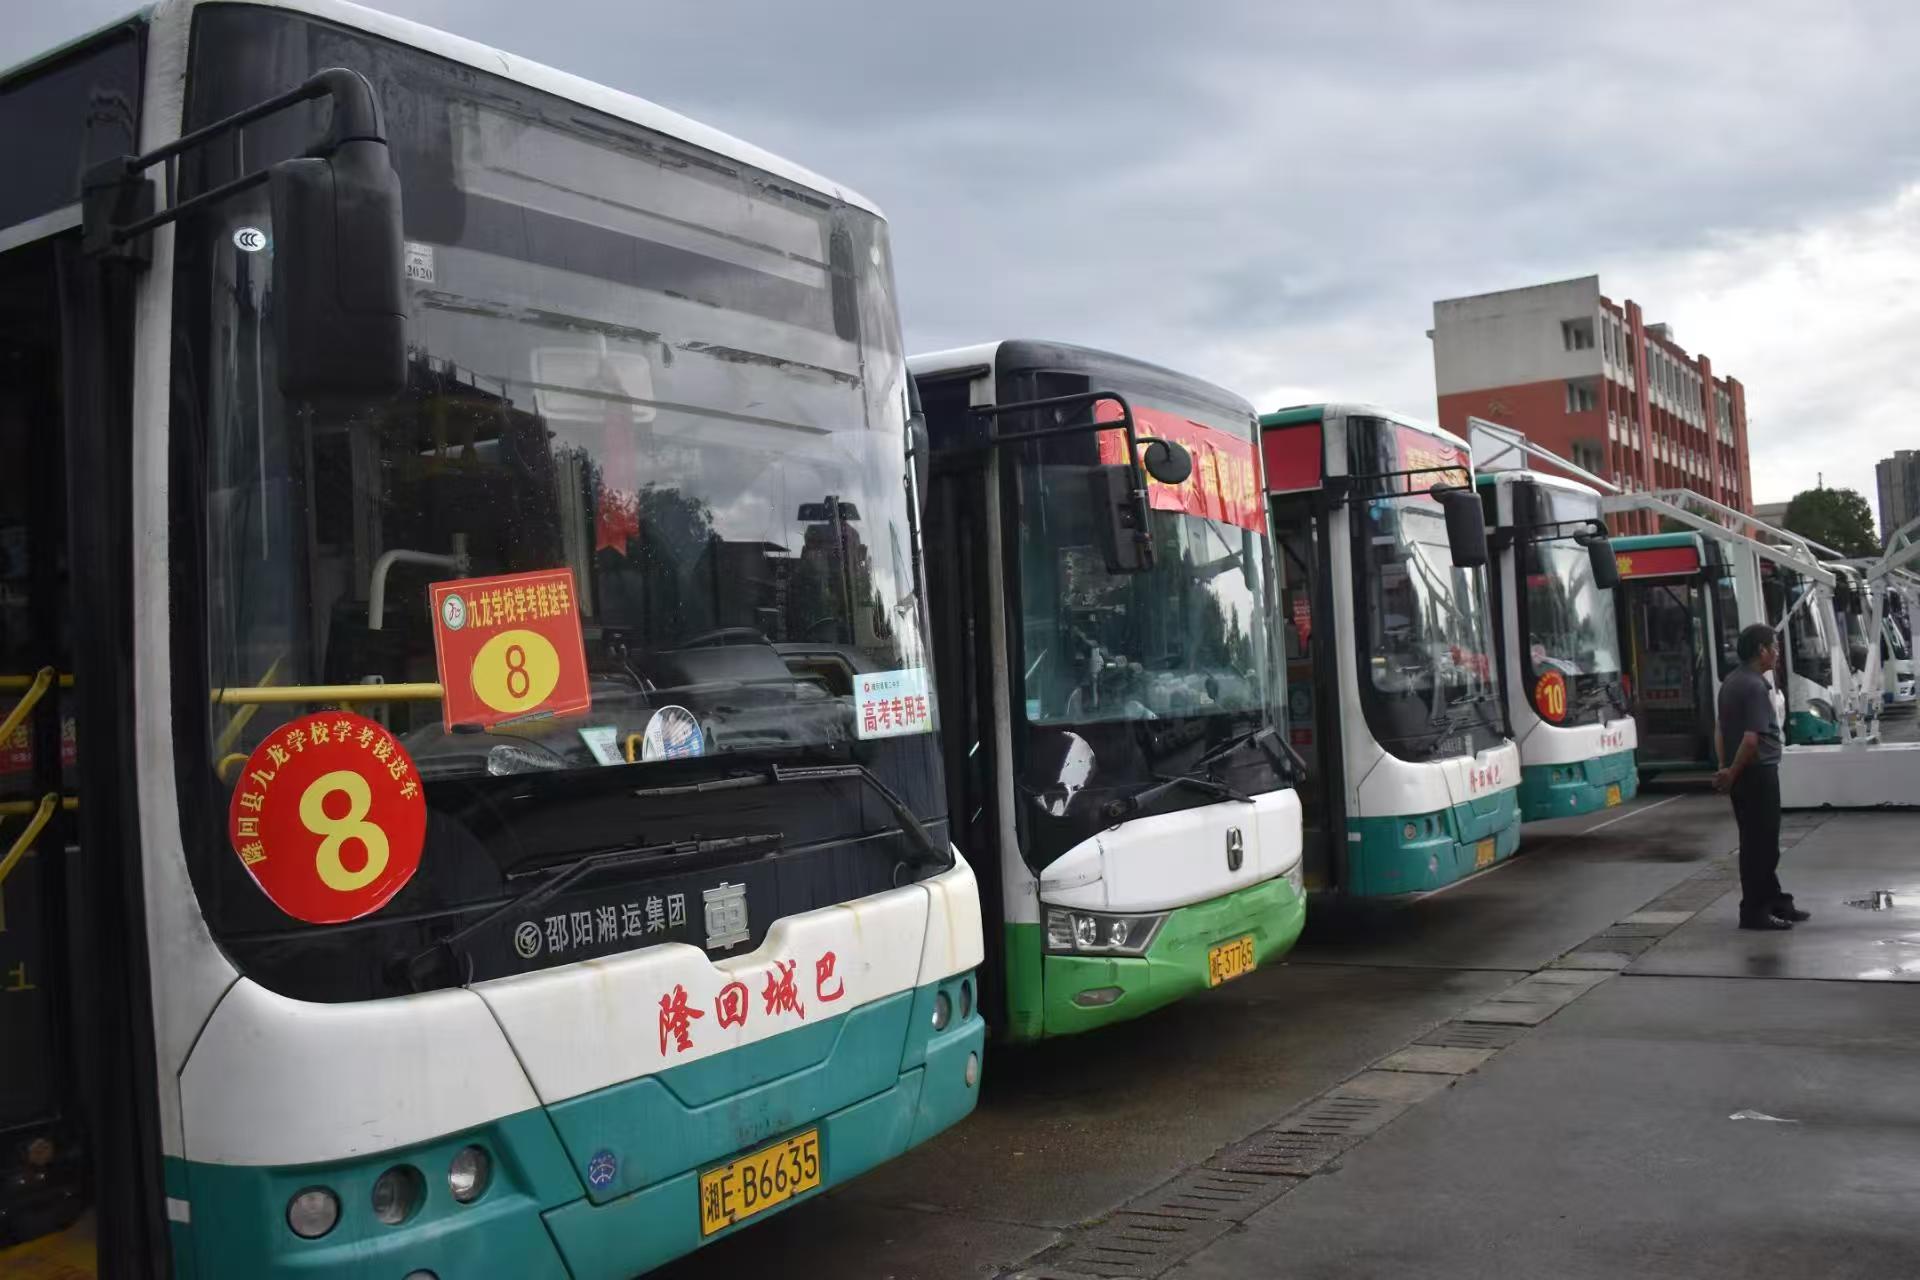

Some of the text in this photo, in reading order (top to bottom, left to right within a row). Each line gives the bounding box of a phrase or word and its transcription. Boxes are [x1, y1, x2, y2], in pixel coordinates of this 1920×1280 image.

[407, 264, 433, 281] 2020
[505, 644, 530, 699] 8
[1543, 683, 1564, 715] 10
[862, 694, 927, 733] 高考专用车
[237, 720, 418, 865] 隆回县九龙学校学考接送车
[299, 770, 390, 892] 8
[544, 893, 687, 953] 邵阳湘运集团
[658, 951, 845, 1057] 隆回城巴
